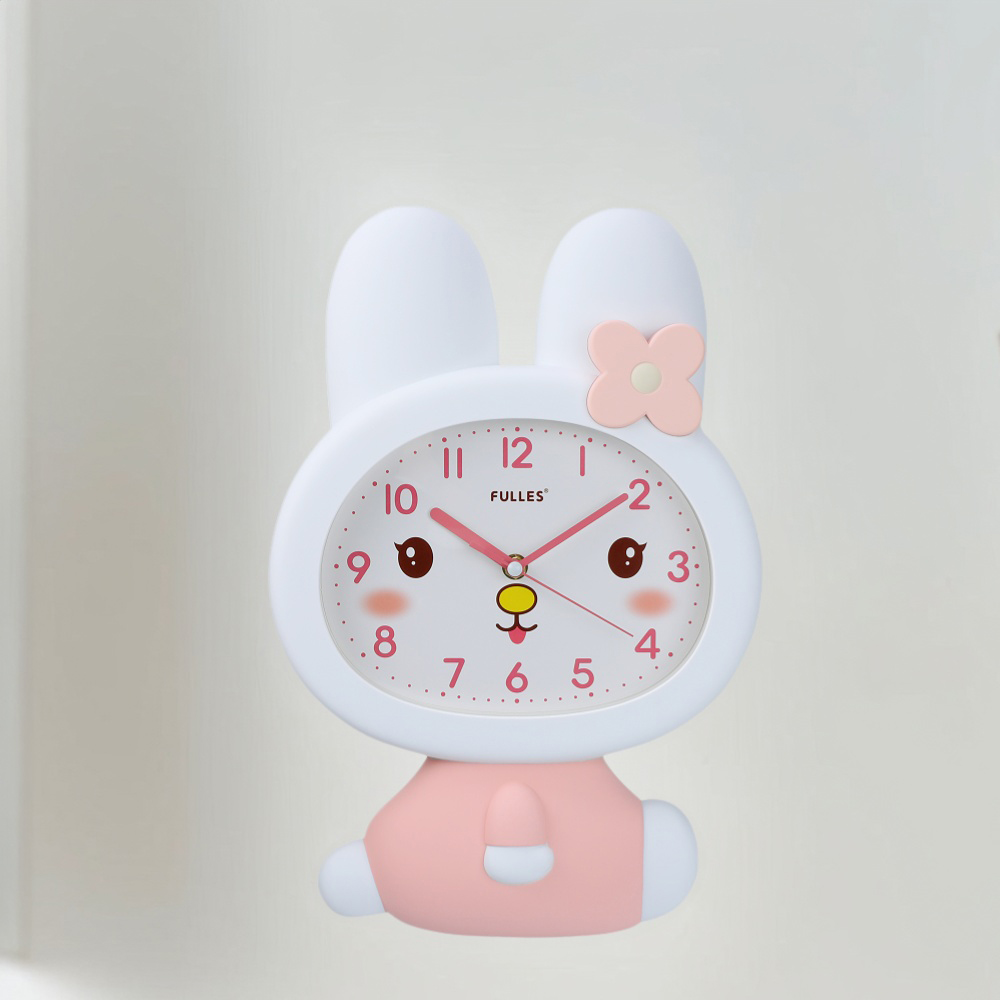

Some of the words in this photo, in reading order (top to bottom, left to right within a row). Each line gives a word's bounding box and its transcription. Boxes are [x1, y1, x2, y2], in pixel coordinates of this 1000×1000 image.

[443, 447, 463, 479] 11
[502, 437, 533, 469] 12
[579, 445, 586, 477] 1
[385, 483, 419, 515] 10
[490, 490, 544, 502] FULLES
[628, 478, 651, 511] 2
[347, 551, 371, 584] 9
[667, 550, 690, 583] 3
[373, 625, 397, 658] 8
[634, 628, 661, 659] 4
[443, 657, 465, 689] 7
[505, 661, 529, 693] 6
[571, 658, 595, 689] 5
